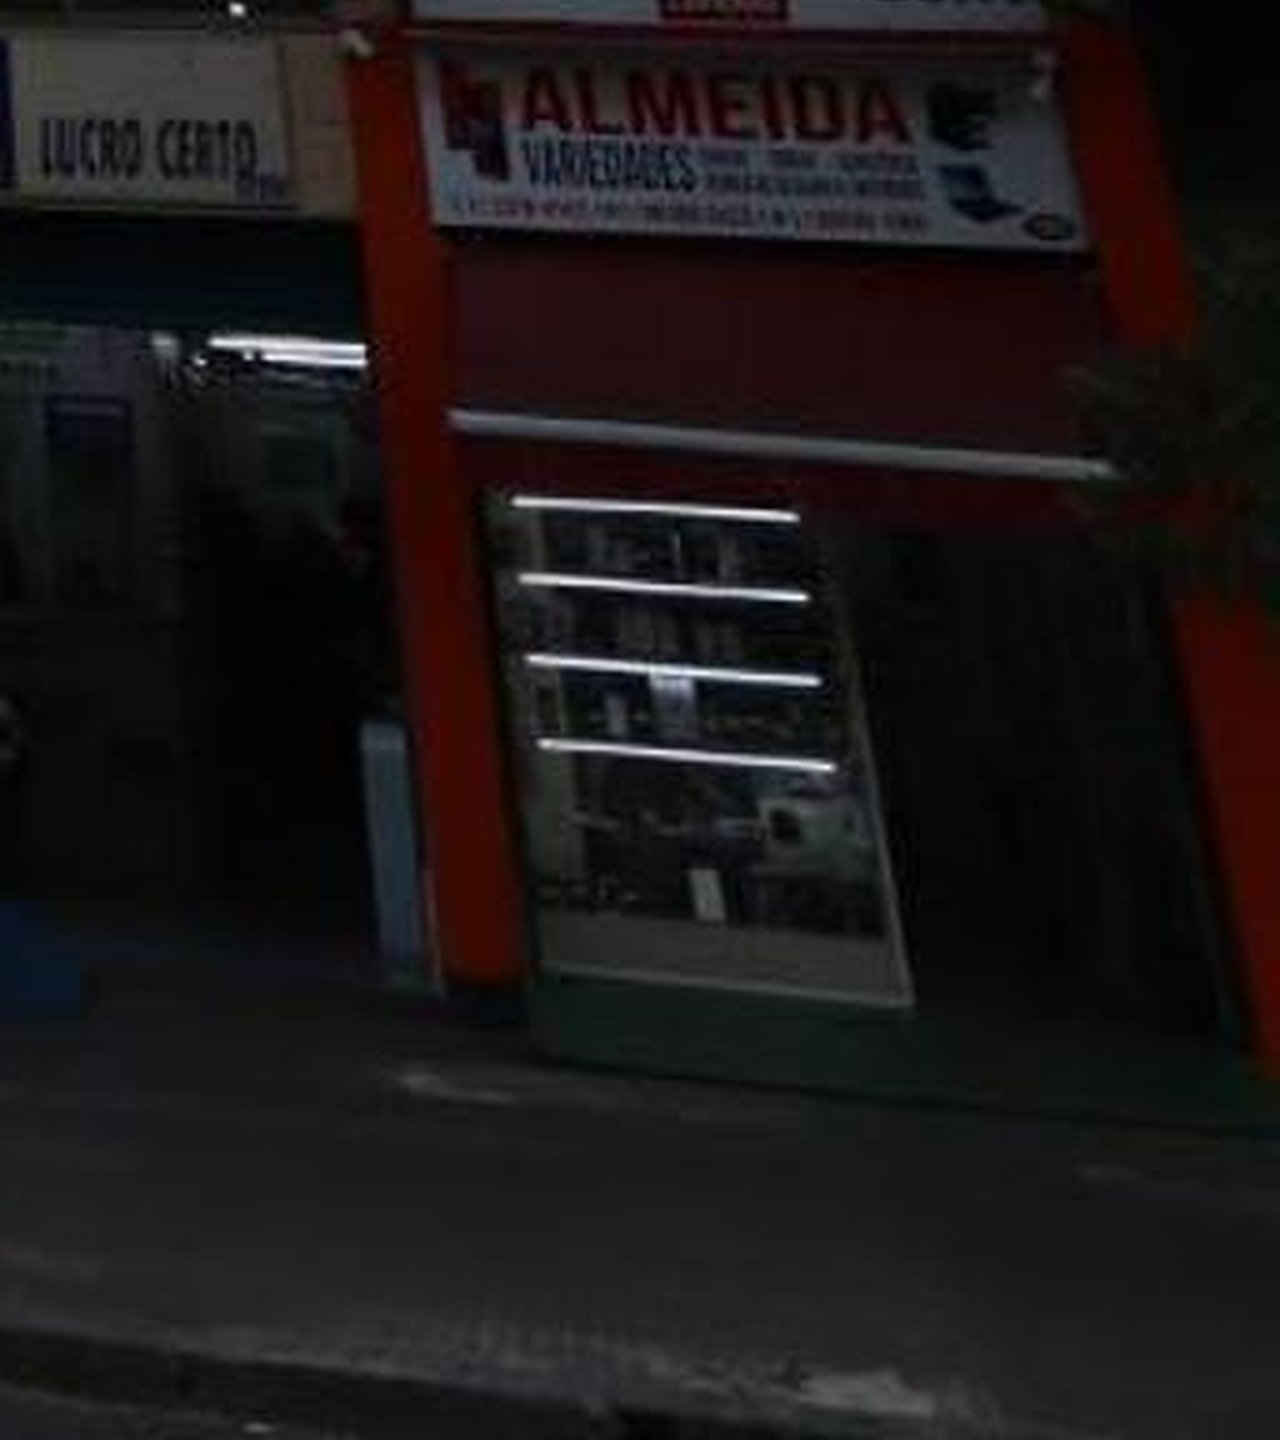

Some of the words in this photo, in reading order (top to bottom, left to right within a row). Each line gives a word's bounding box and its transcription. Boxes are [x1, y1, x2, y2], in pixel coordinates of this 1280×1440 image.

[520, 66, 911, 143] ALMEIDA
[41, 118, 142, 176] LUCRO
[157, 118, 259, 180] CERTO
[519, 140, 697, 195] VARIEDADES
